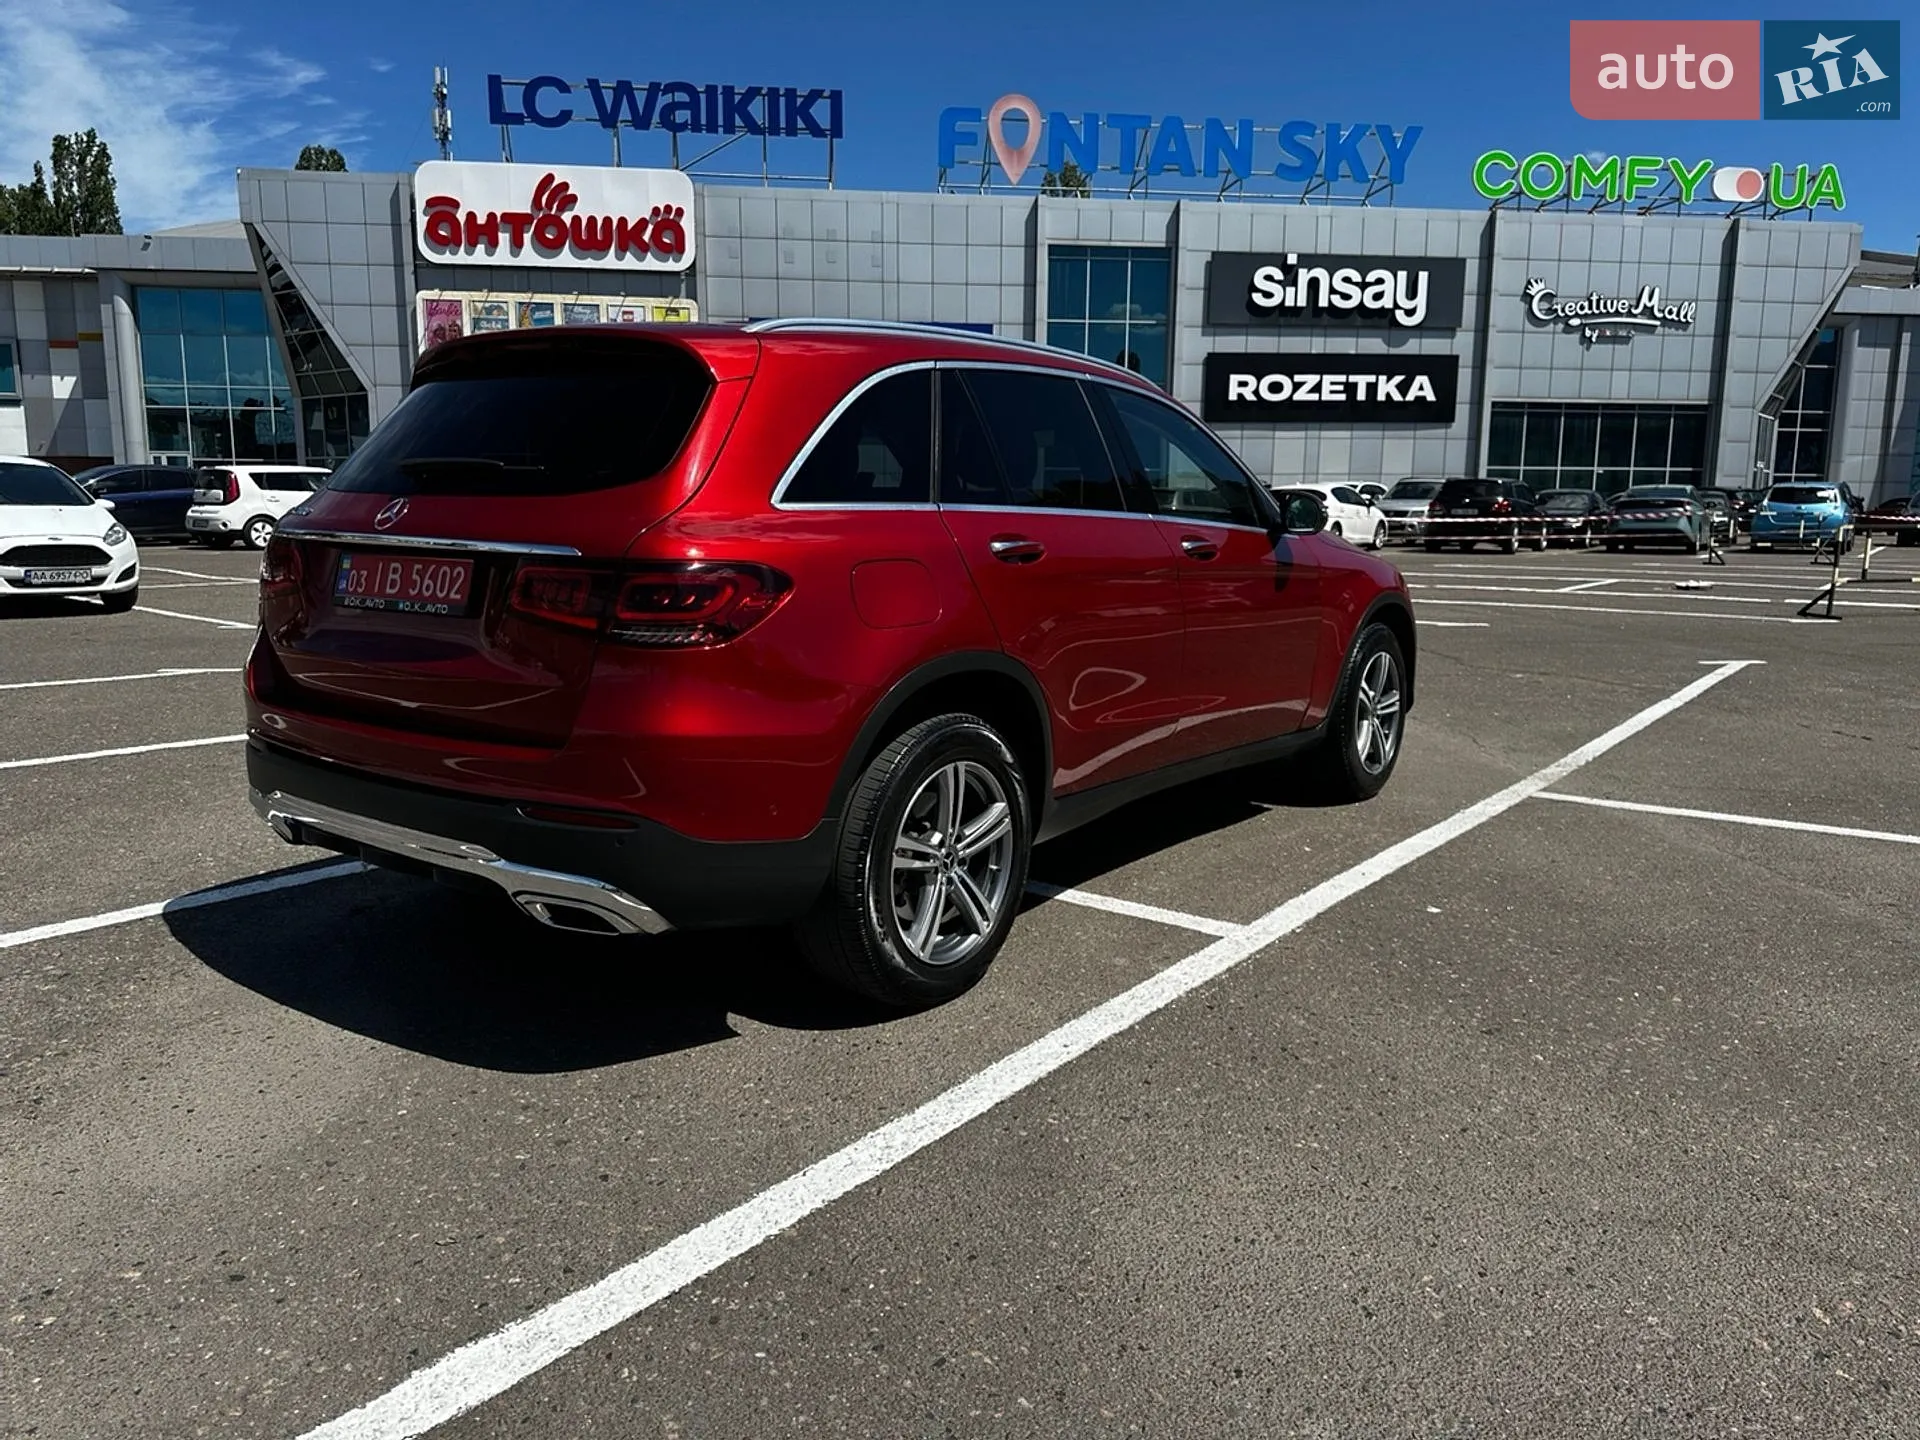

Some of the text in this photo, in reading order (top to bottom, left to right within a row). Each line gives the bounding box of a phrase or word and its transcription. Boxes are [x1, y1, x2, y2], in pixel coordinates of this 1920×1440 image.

[487, 74, 573, 128] LC
[938, 94, 1423, 185] FONTAN SKY
[1473, 149, 1846, 211] COMFY UA
[1251, 253, 1429, 327] sinsay
[1532, 285, 1696, 323] Creative Mall
[1228, 374, 1437, 402] ROZETKA
[348, 561, 465, 599] 03 IB 5602
